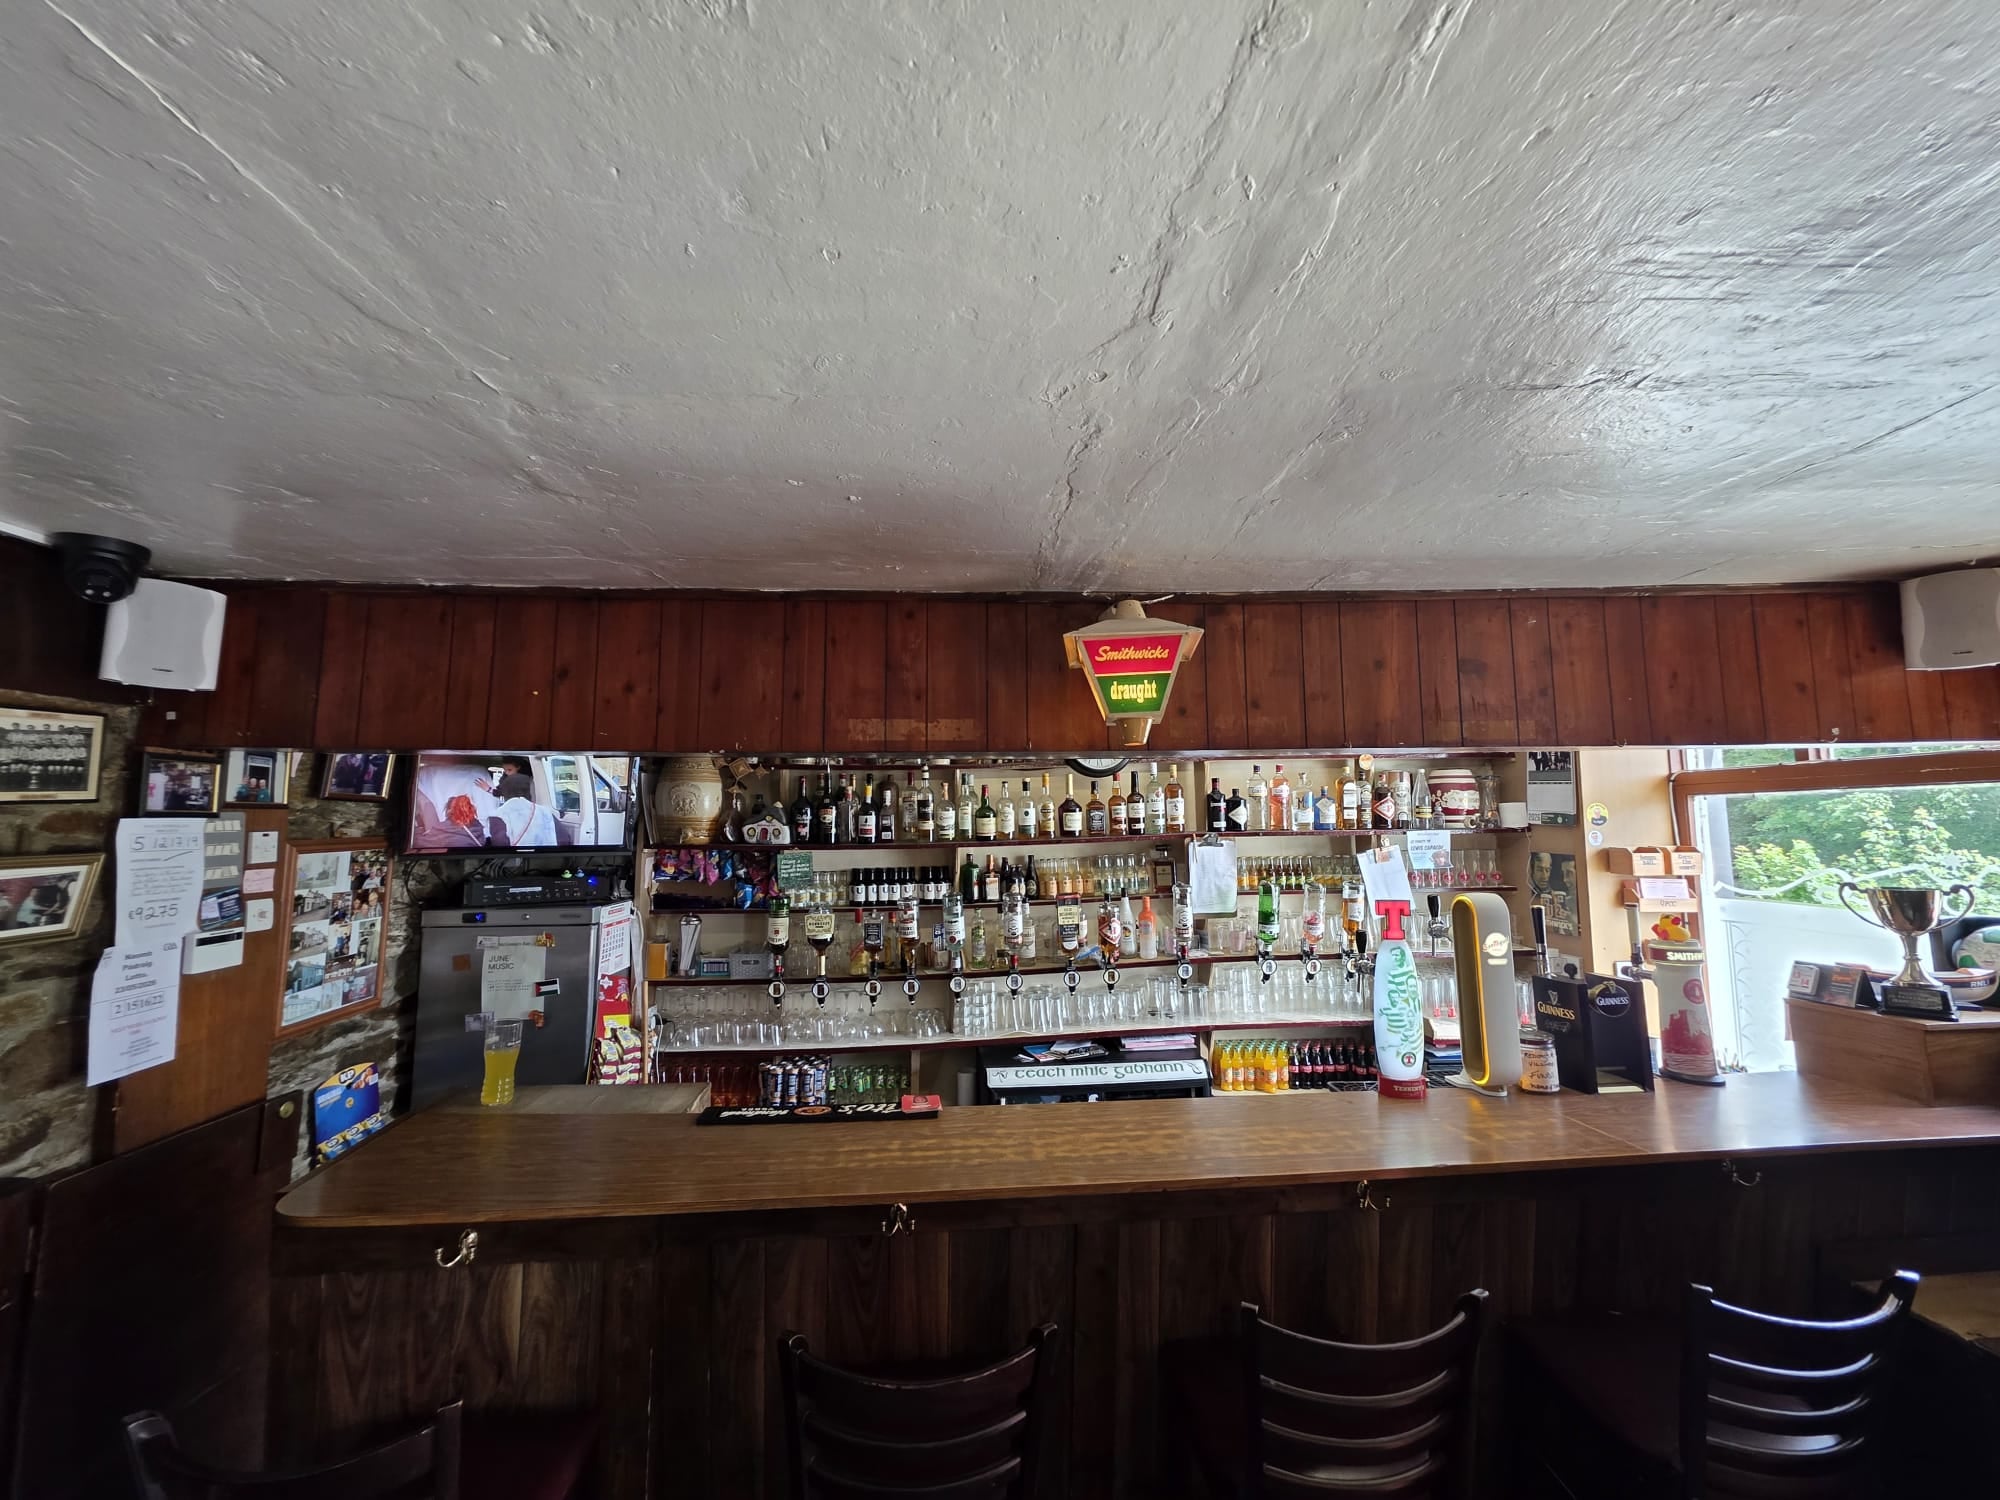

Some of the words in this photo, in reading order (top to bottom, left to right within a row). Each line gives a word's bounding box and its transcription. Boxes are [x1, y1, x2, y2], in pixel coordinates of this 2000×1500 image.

[1094, 645, 1169, 662] Smithwicks
[1110, 679, 1157, 704] draught
[1375, 900, 1411, 940] T
[488, 955, 510, 963] JUNE
[488, 962, 515, 970] MUSIC
[1595, 996, 1630, 1006] GUINNESS
[1537, 1001, 1576, 1020] GUINNESS
[1404, 1055, 1413, 1063] T
[1014, 1066, 1066, 1079] teach
[1070, 1064, 1109, 1078] mhic
[1113, 1062, 1185, 1080] gabhann
